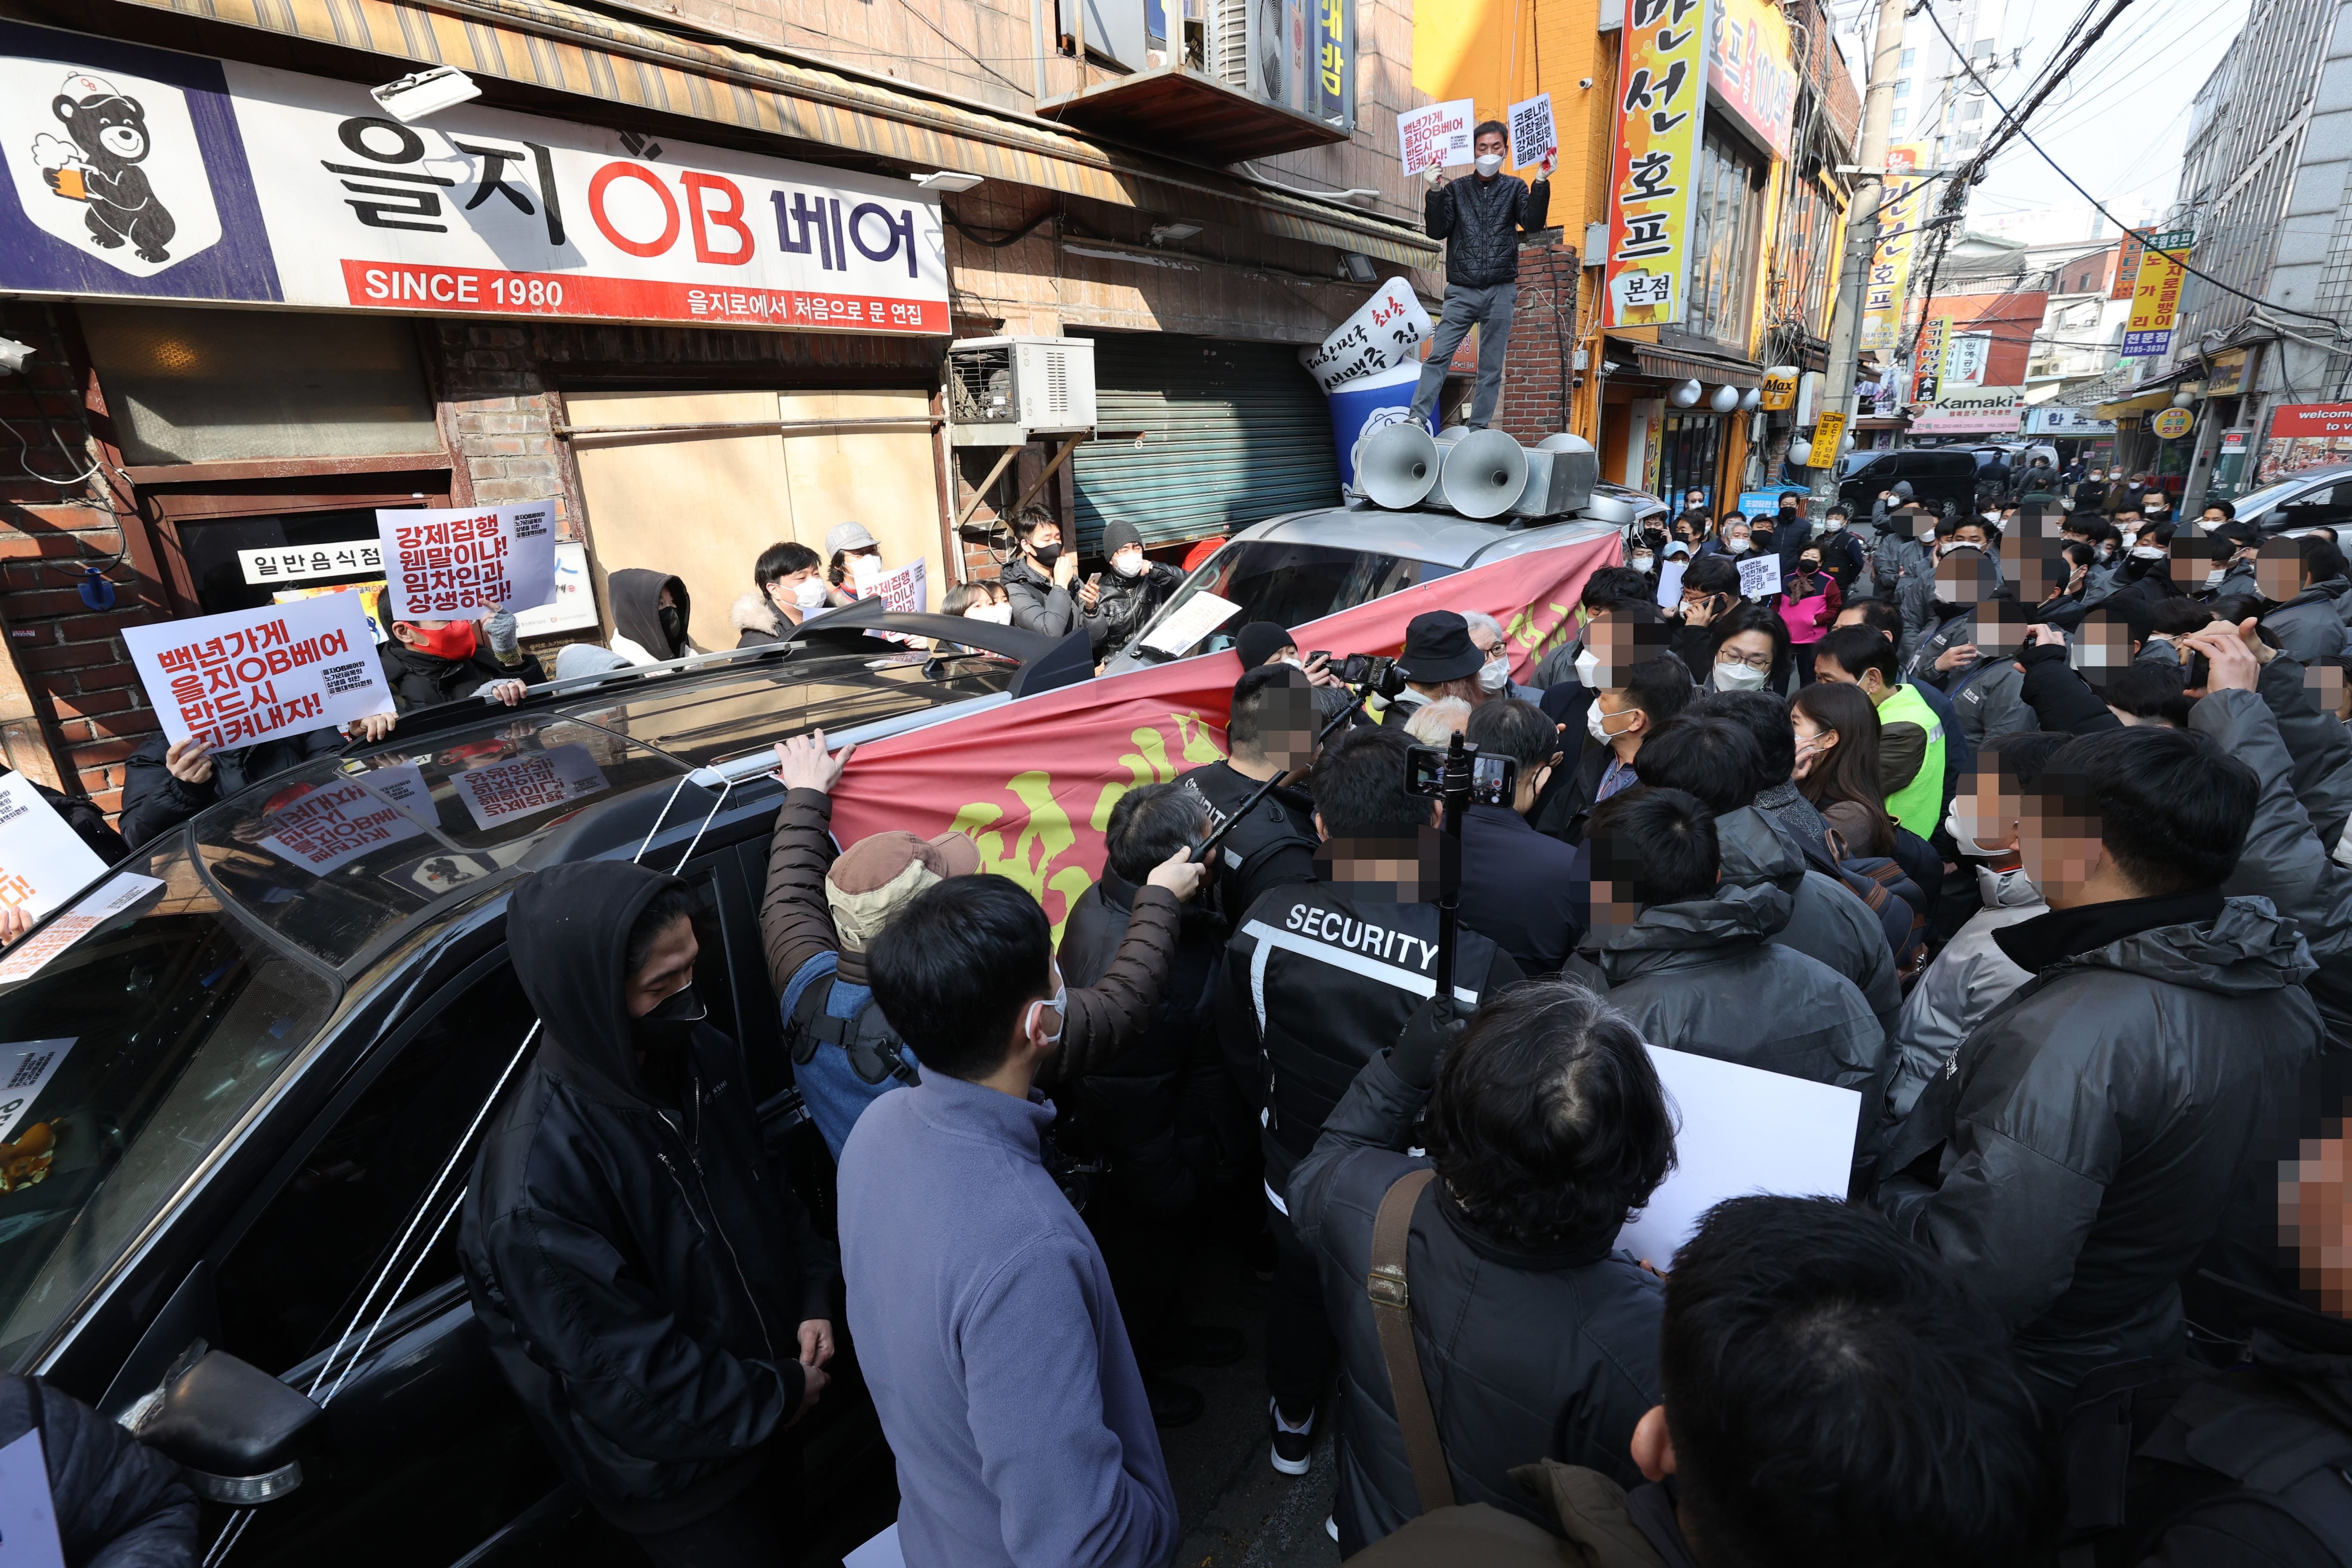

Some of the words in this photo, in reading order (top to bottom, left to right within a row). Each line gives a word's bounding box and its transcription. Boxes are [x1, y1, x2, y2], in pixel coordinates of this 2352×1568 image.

[1295, 52, 1301, 70] LG
[1404, 110, 1443, 135] 백년가게
[1515, 99, 1549, 127] 코로나19
[1405, 117, 1463, 149] 을지OB베어
[1516, 125, 1551, 152] 강제집행
[1407, 140, 1432, 161] 반드시
[2149, 233, 2191, 249] 초원호프
[365, 269, 480, 303] SINCE
[491, 279, 563, 307] 1980
[1624, 276, 1671, 303] 본점
[2132, 255, 2161, 327] 노가리
[687, 288, 788, 319] 을지로에서
[795, 296, 864, 322] 처음으로
[869, 301, 885, 323] 문
[891, 302, 922, 326] 연집
[2127, 332, 2169, 343] 전문점
[1765, 379, 1794, 390] Max
[1935, 396, 2013, 409] Kamaki
[396, 514, 499, 549] 강제집행
[255, 548, 381, 576] 일반음식점
[399, 536, 508, 572] 웬말이냐!
[403, 561, 504, 593] 임차인과
[407, 580, 512, 614] 상생하라!
[882, 583, 914, 608] 말이냐!
[157, 619, 290, 674] 백년가게
[171, 629, 348, 705] 을지OB베어
[325, 668, 362, 681] 노가리골목의
[180, 680, 278, 731] 반드시
[191, 692, 323, 749] 지켜내자!
[1285, 904, 1439, 970] SECURITY
